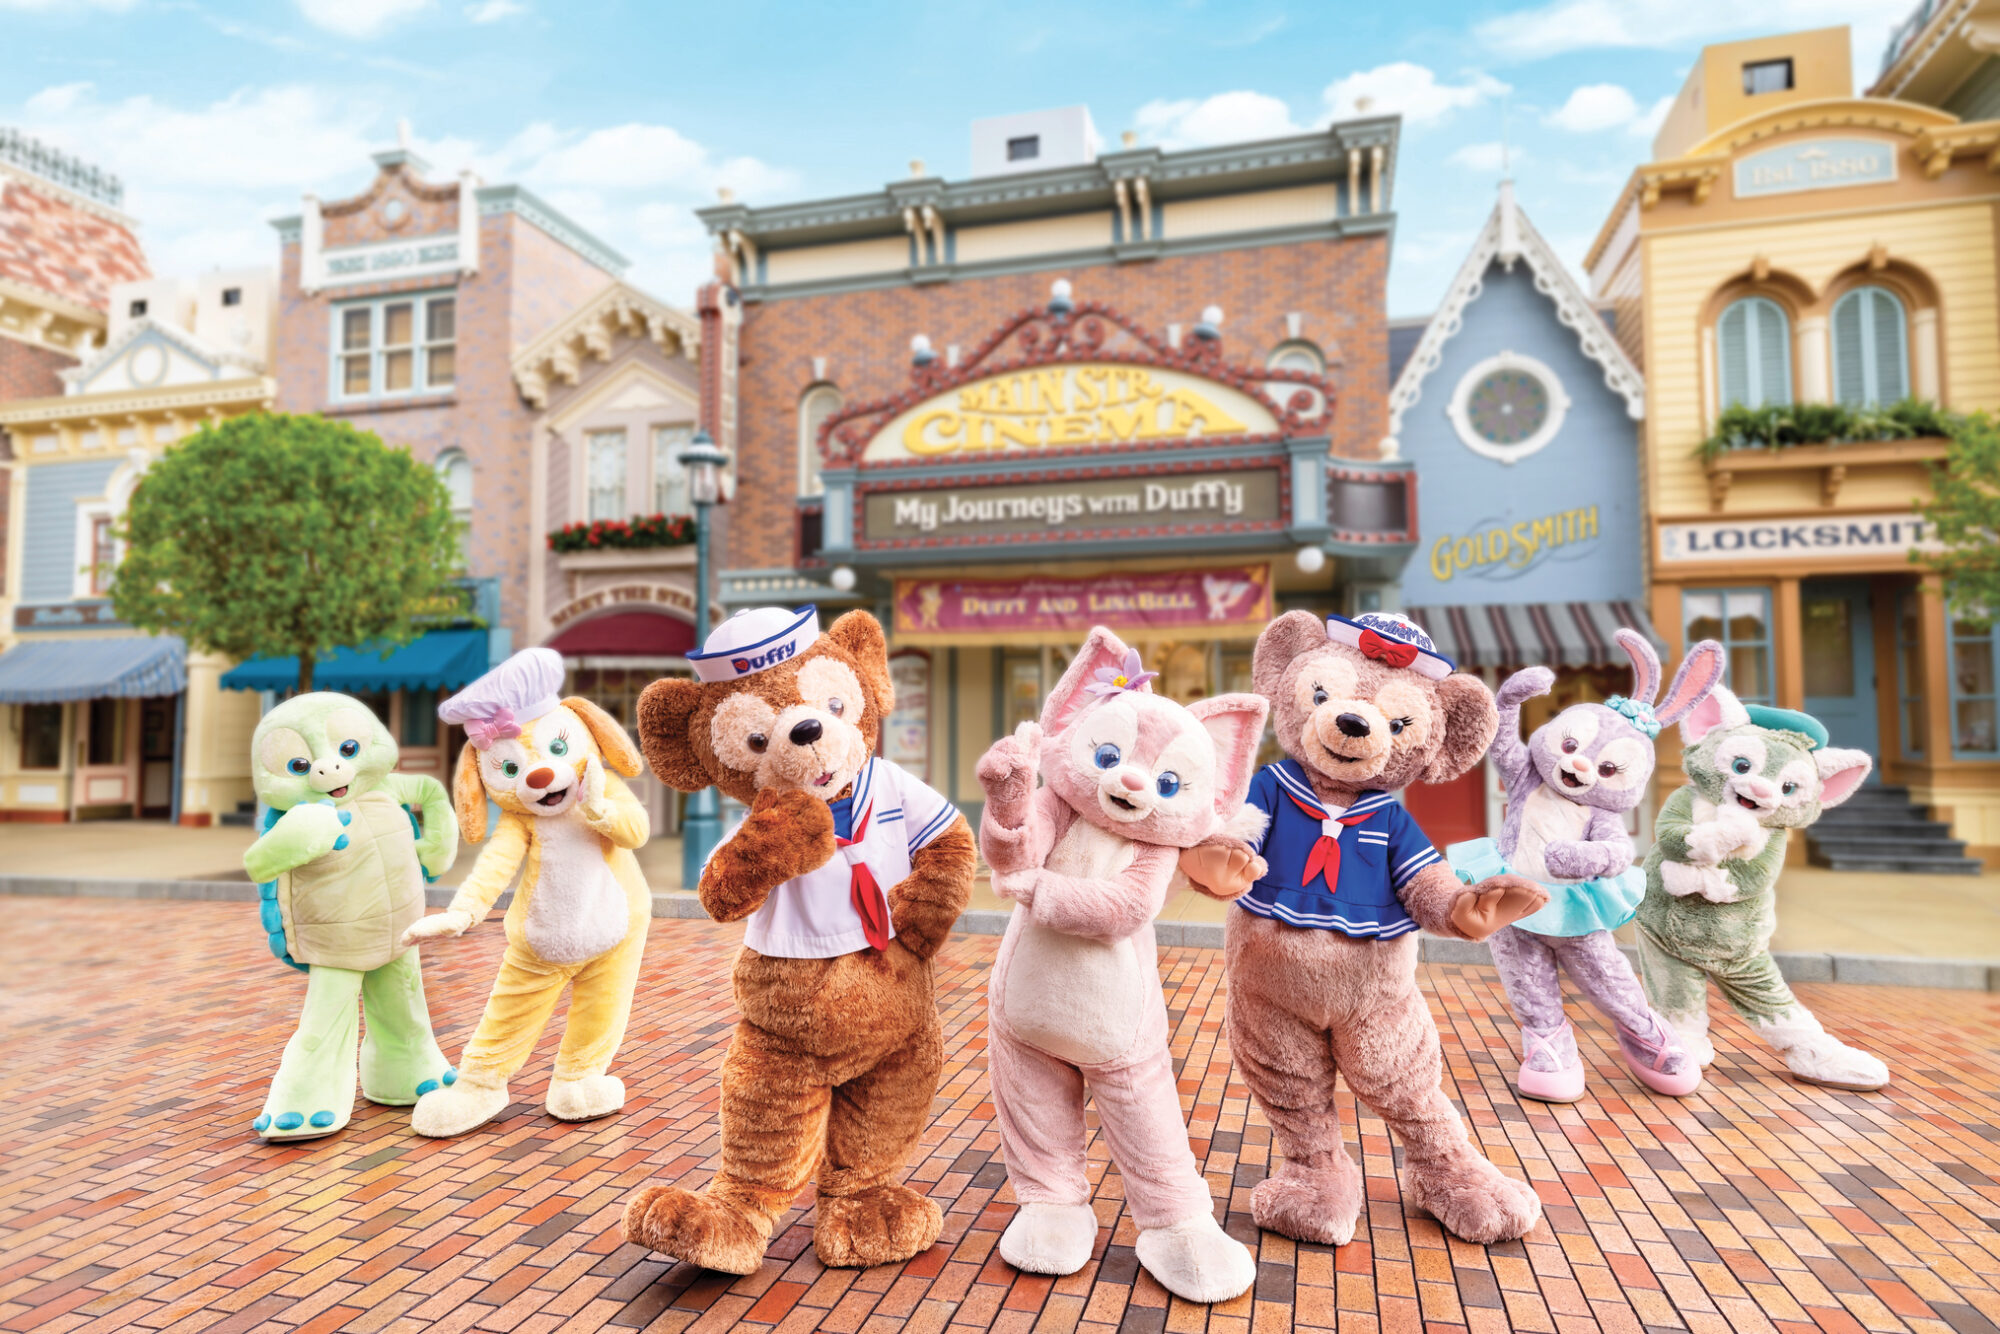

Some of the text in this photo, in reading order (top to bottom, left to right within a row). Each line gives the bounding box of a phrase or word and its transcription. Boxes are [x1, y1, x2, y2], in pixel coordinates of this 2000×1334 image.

[959, 370, 1066, 415] MAIN
[903, 388, 1248, 456] CINEMA
[895, 497, 937, 532] My
[941, 493, 1083, 525] Journeys
[1145, 481, 1243, 515] Duffy
[1430, 504, 1598, 582] GOLDSMITH
[1688, 521, 1928, 552] LOCKSMIT
[551, 591, 605, 627] MEET
[610, 586, 651, 601] THE
[1036, 596, 1079, 614] AND
[1357, 614, 1433, 652] ShellieMay
[731, 638, 797, 675] Duffy
